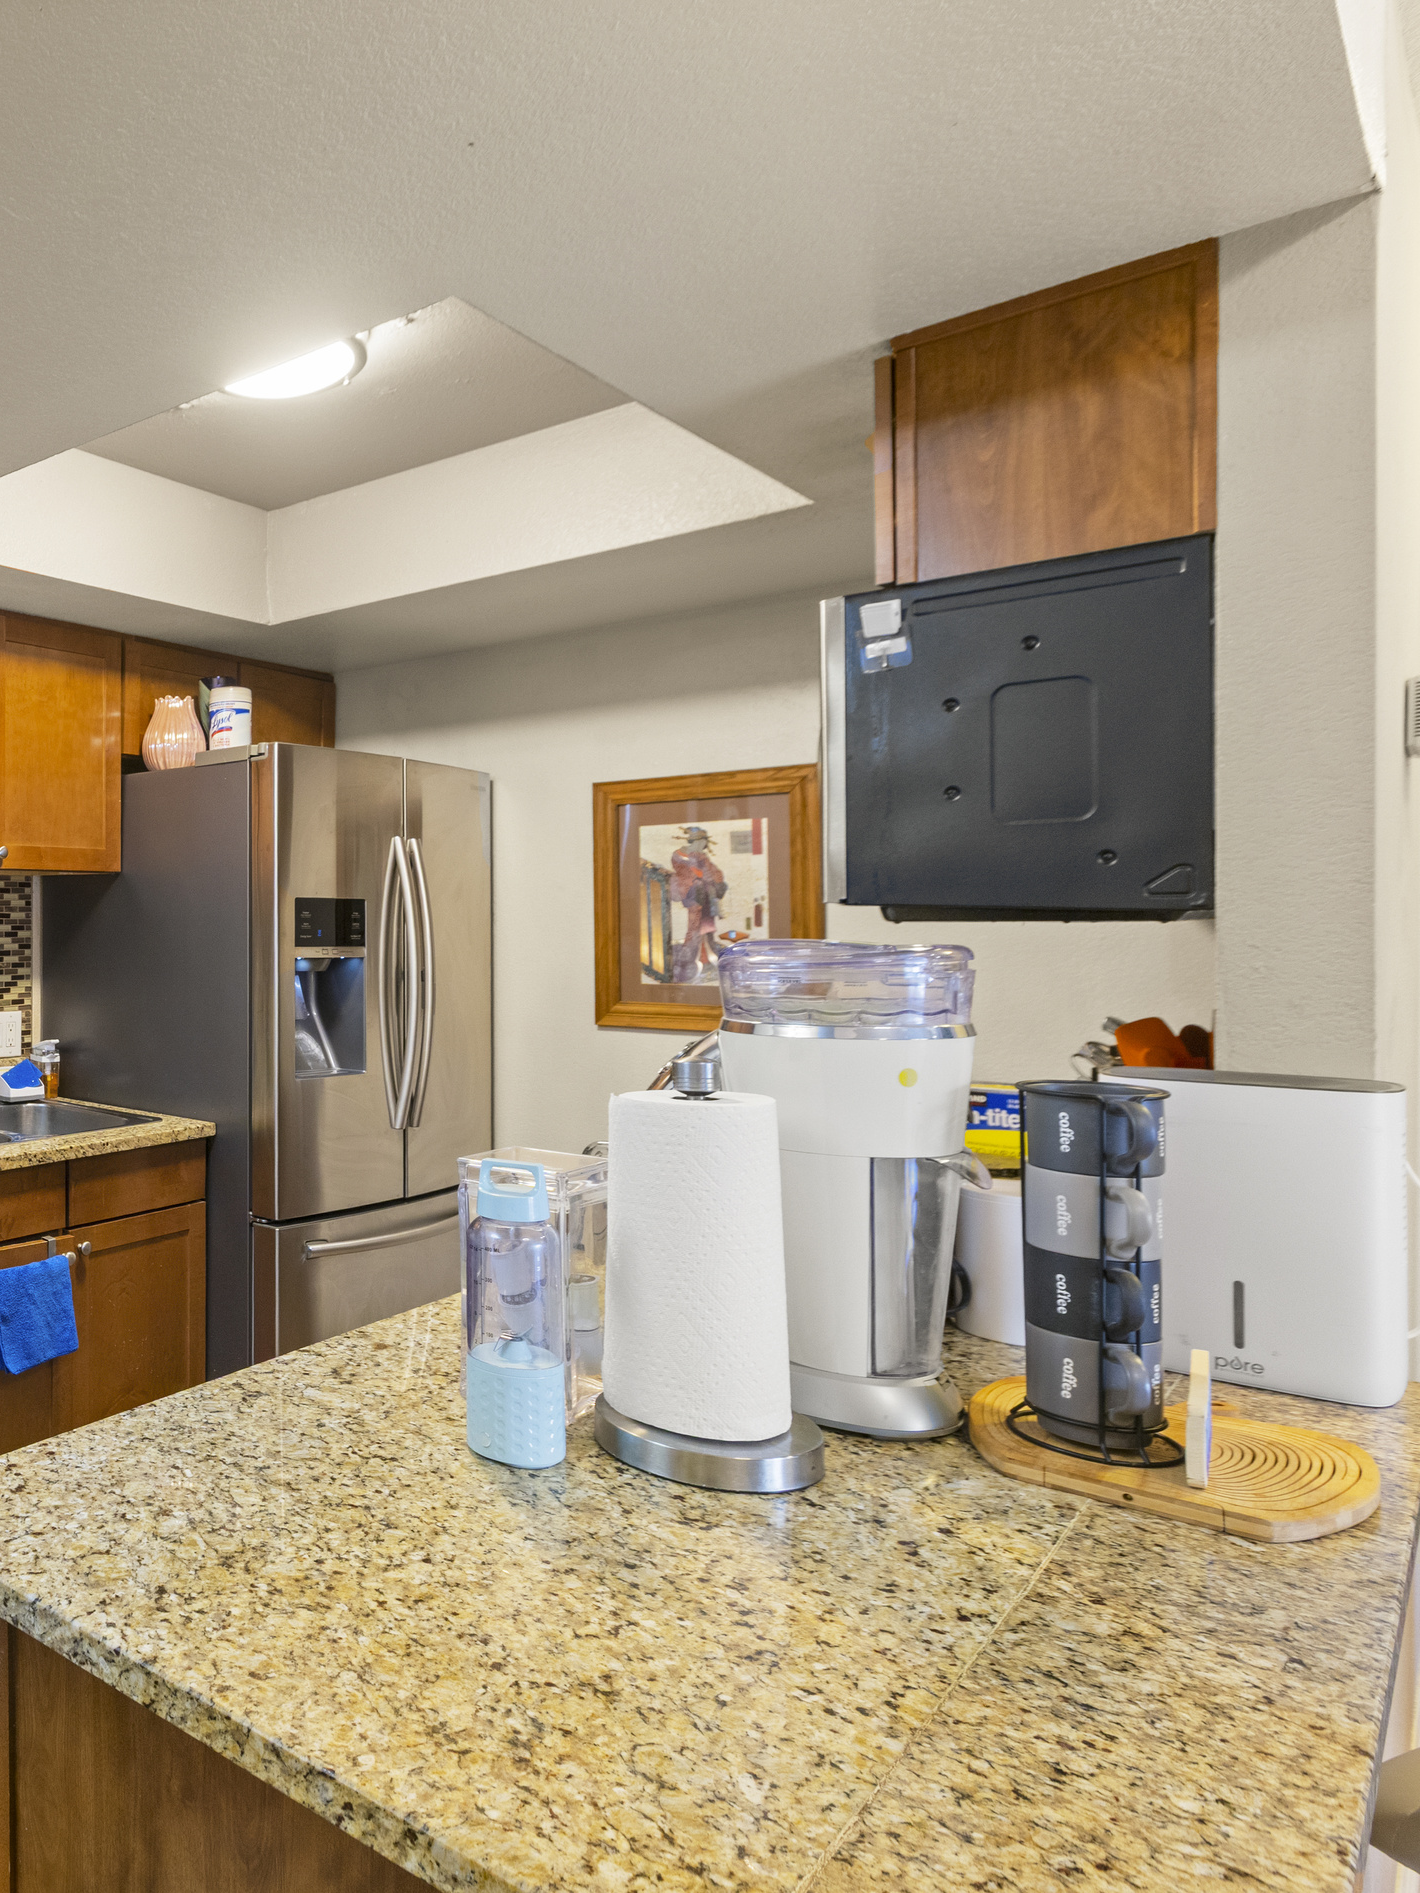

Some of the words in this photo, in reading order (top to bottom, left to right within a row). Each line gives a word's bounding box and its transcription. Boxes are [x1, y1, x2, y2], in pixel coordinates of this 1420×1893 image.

[212, 711, 234, 730] Lysol
[1059, 1111, 1075, 1153] coffee
[1056, 1194, 1072, 1236] coffee
[1055, 1273, 1071, 1315] coffee
[1151, 1284, 1160, 1324] coffee
[1060, 1357, 1078, 1399] coffee
[1151, 1364, 1161, 1405] coffee
